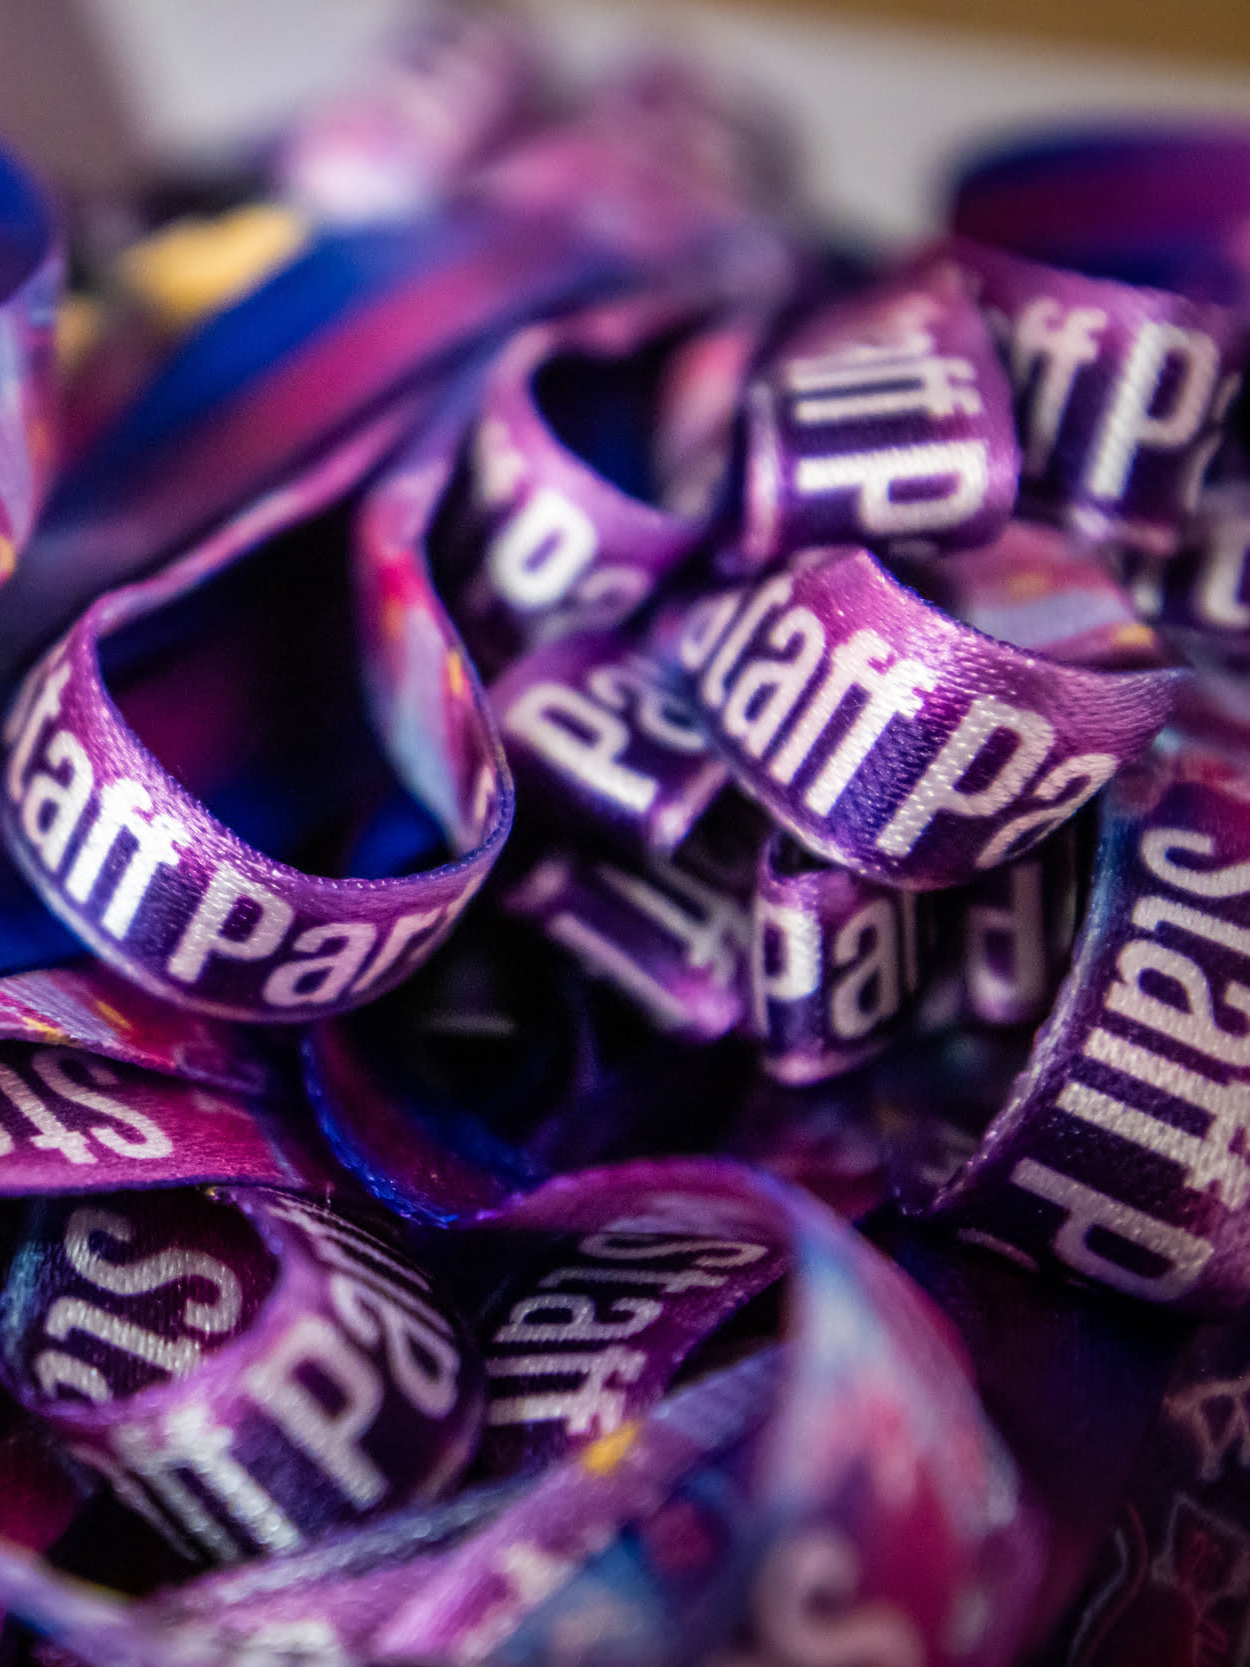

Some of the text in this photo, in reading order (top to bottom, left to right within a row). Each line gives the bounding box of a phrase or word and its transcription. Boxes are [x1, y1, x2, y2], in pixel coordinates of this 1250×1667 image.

[1088, 318, 1239, 512] P
[958, 1157, 1216, 1303] P
[485, 1230, 770, 1437] Staff
